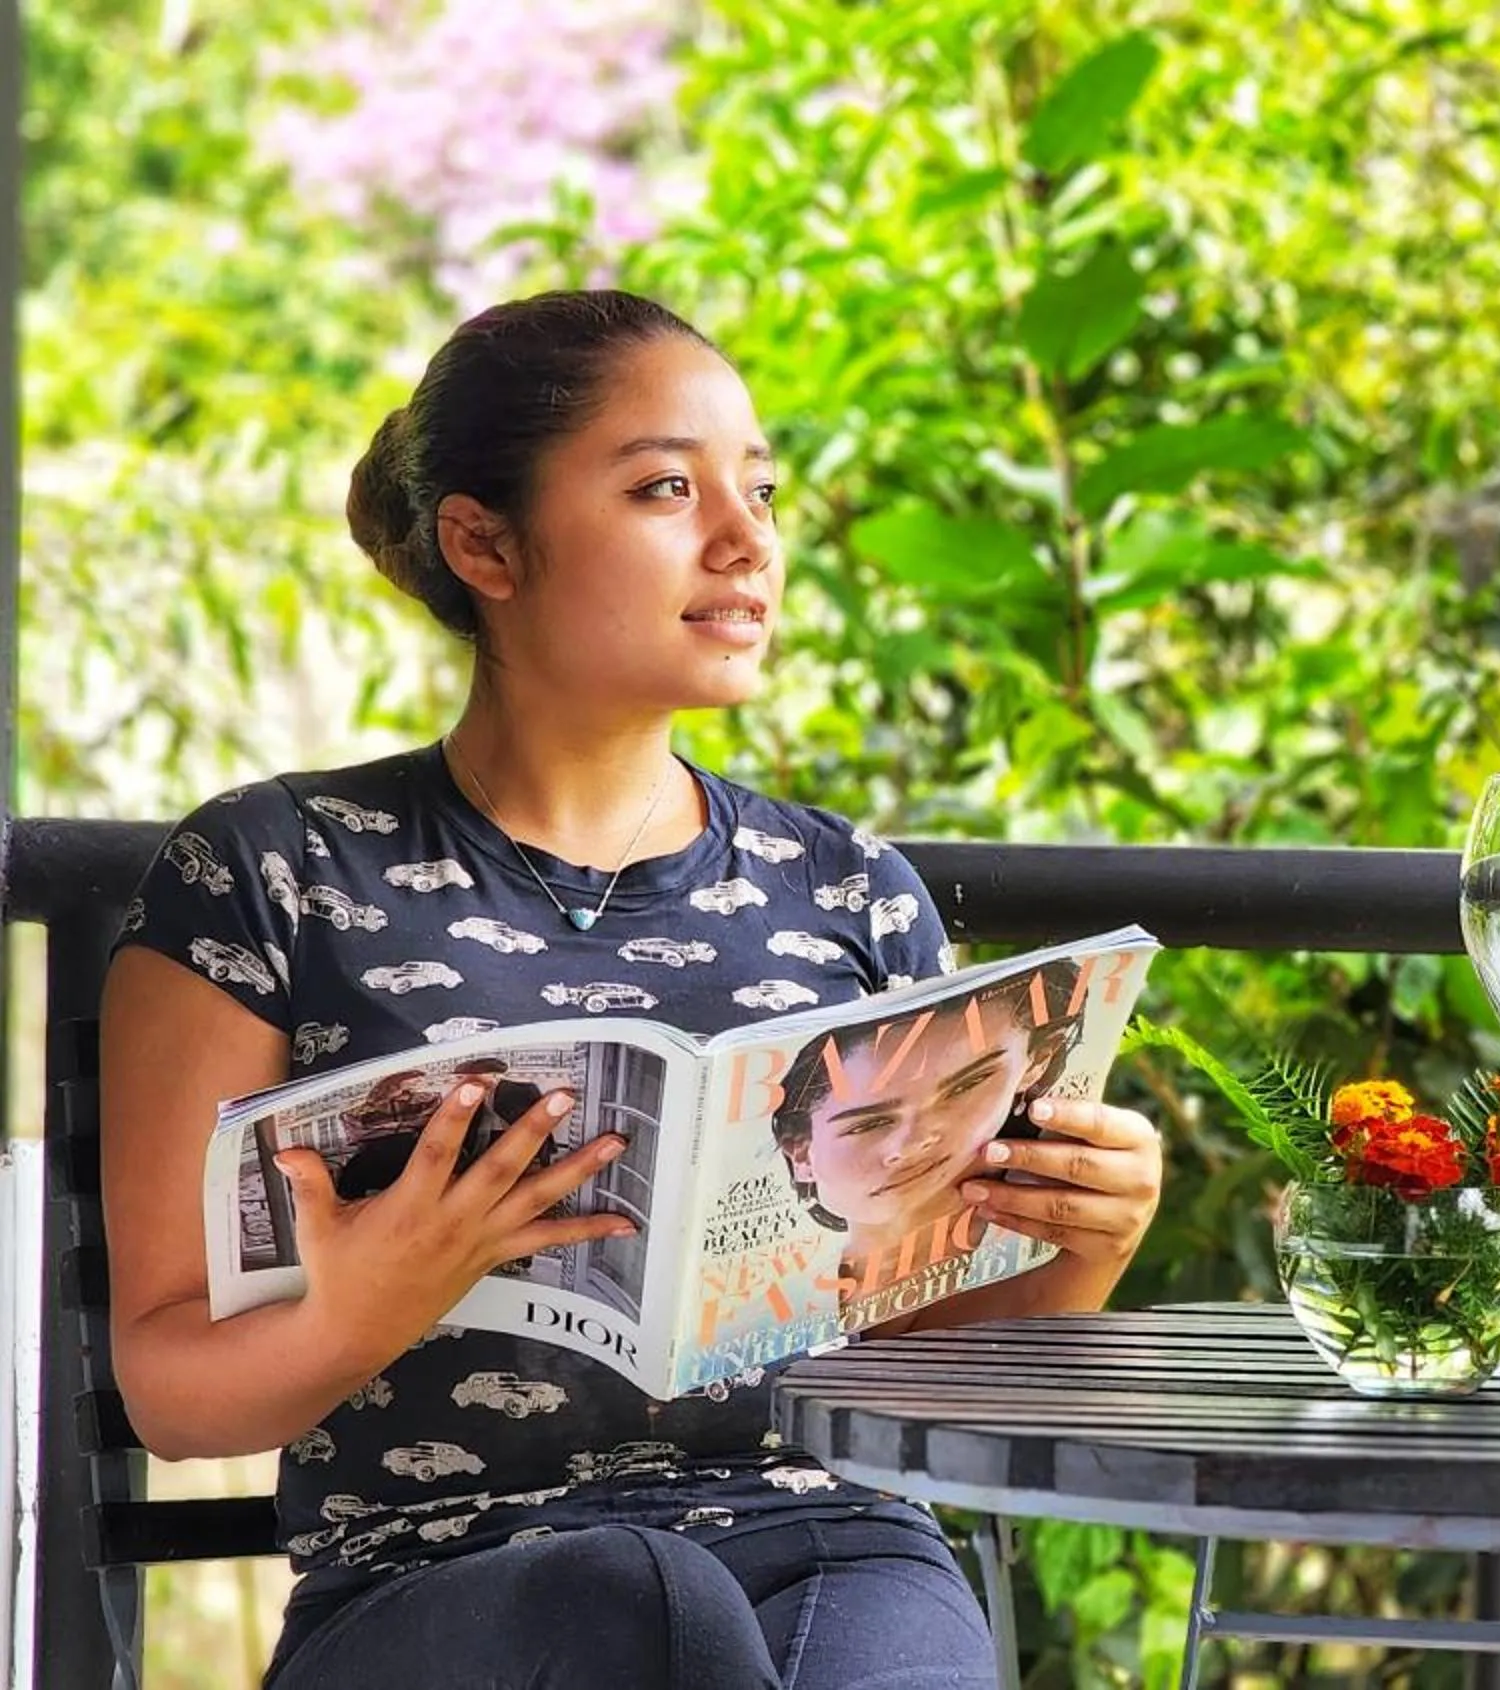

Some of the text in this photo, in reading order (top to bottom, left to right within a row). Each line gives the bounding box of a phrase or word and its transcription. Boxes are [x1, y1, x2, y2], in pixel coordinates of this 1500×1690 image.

[726, 951, 1136, 1125] BAZAAR
[702, 1215, 798, 1252] BEAUTY
[704, 1207, 797, 1236] NATURAL
[698, 1204, 978, 1347] FASHIO
[526, 1301, 638, 1371] DIOR
